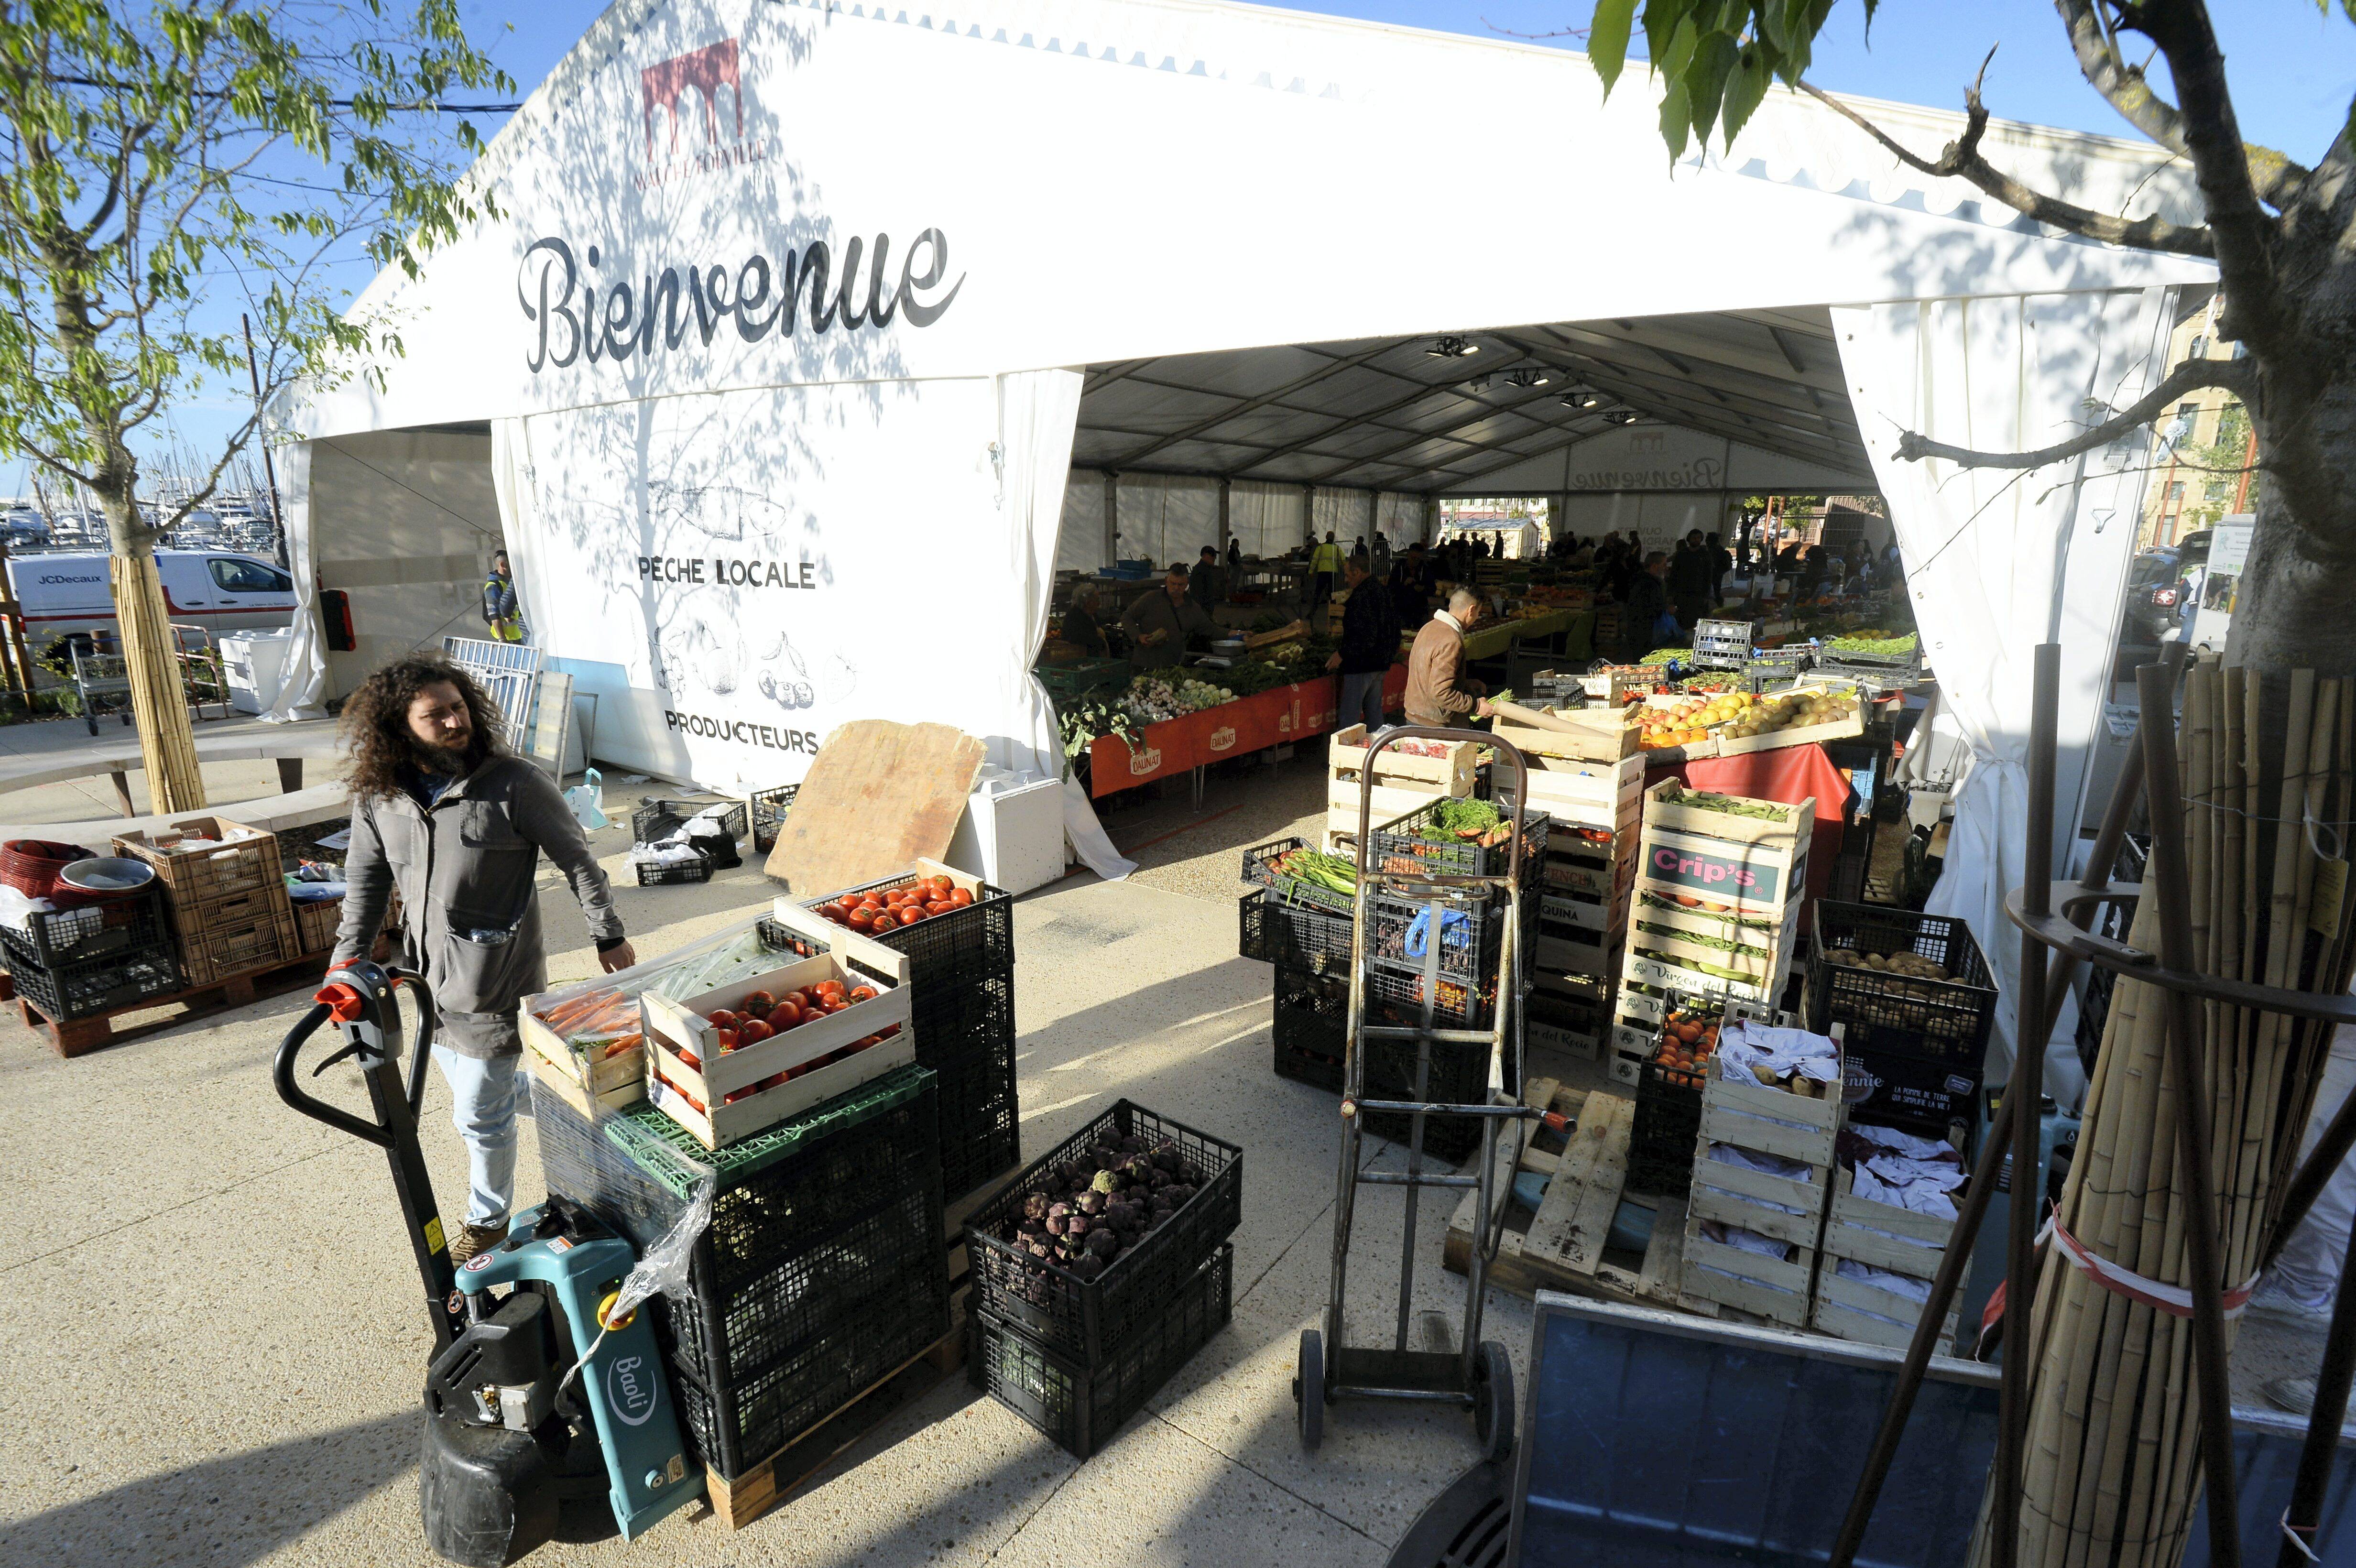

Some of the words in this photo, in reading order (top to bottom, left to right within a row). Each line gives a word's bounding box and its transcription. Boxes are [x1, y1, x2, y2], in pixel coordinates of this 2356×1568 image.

[518, 228, 966, 374] Bienvenue
[39, 575, 102, 585] JCDecaux
[715, 559, 816, 589] LOCALE
[665, 710, 819, 756] PRODUCTEURS
[1211, 733, 1234, 748] DAUNAT
[1133, 754, 1160, 773] DAUNAT
[1654, 849, 1756, 887] Crip's
[1541, 905, 1578, 921] QUINA
[1651, 965, 1697, 990] Virgen
[1702, 980, 1721, 993] del
[1725, 983, 1758, 1003] Rocio
[1561, 1033, 1590, 1050] Rocio
[1891, 1093, 1902, 1102] QUI
[1902, 1096, 1927, 1107] SIMPLIFIE
[1928, 1100, 1935, 1109] LA
[1937, 1101, 1947, 1110] VIE
[1903, 1087, 1922, 1098] POMME
[1923, 1090, 1931, 1099] DE
[1933, 1092, 1951, 1102] TERRE
[616, 1356, 648, 1409] Baoli
